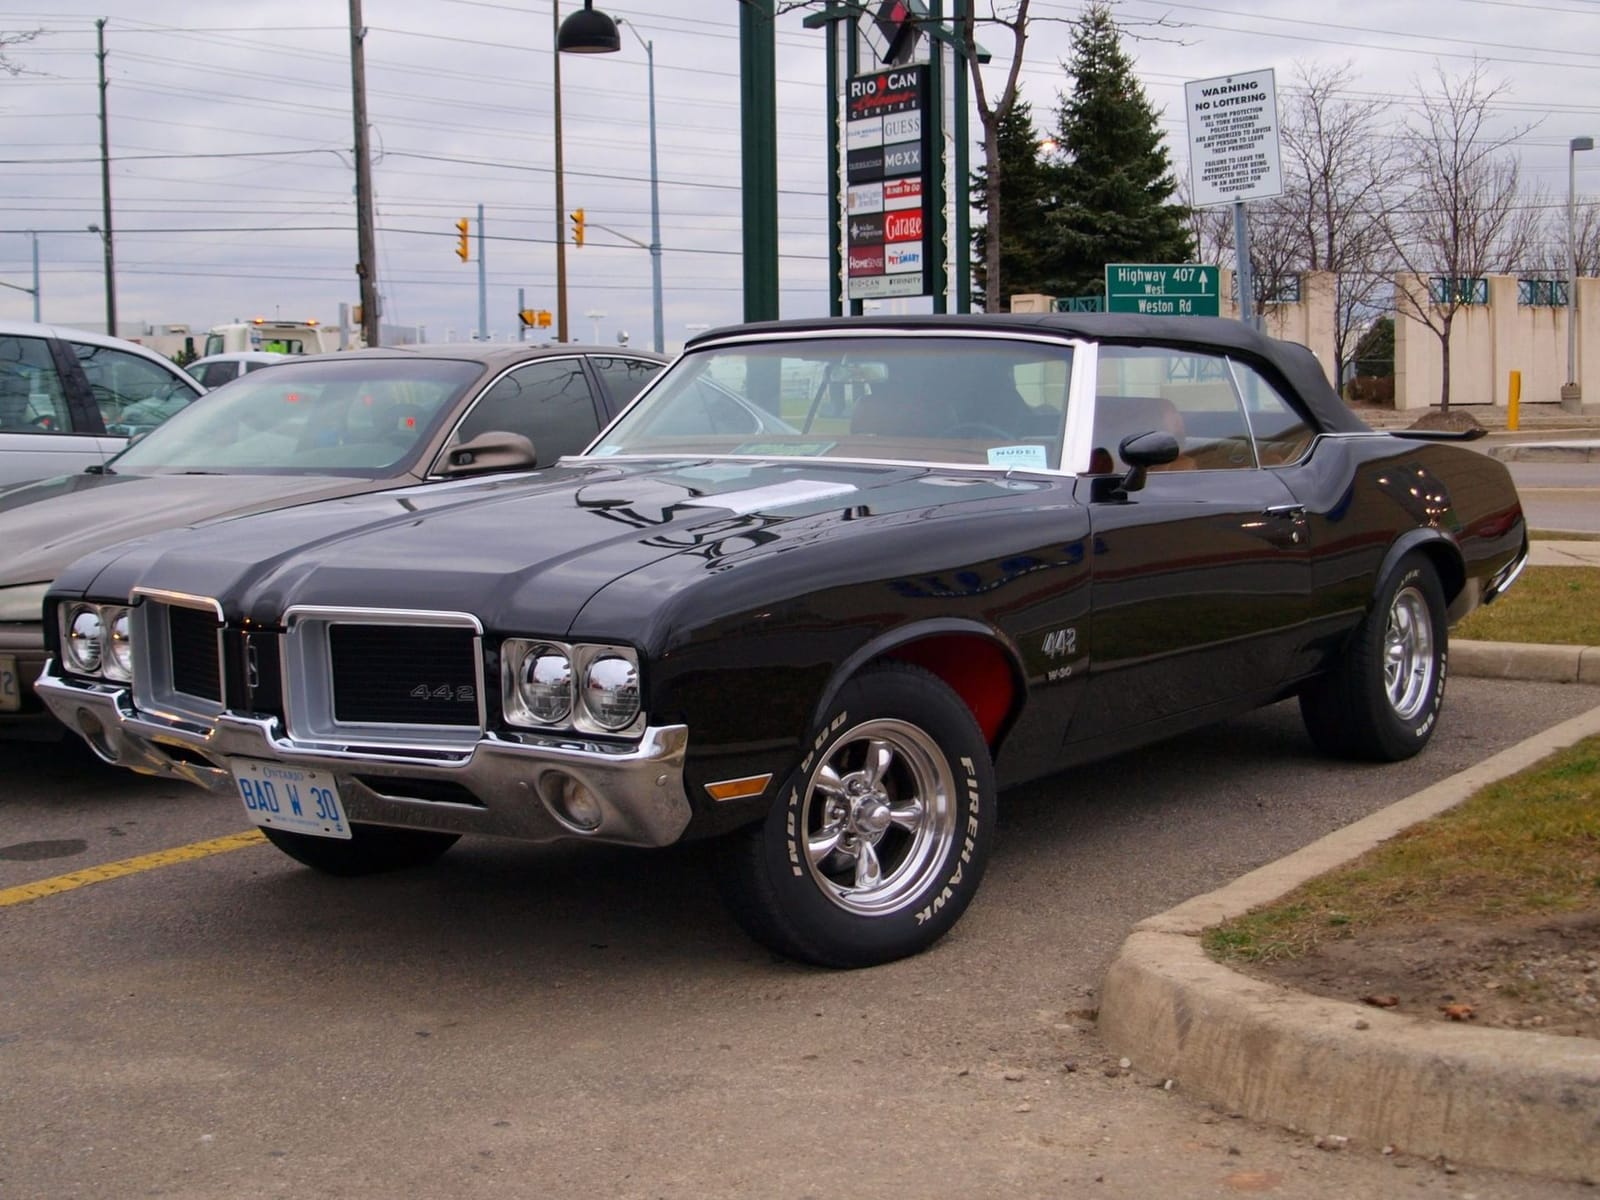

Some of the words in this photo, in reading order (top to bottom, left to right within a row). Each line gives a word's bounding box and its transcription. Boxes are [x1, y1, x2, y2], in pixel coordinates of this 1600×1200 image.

[851, 81, 876, 97] RIO
[888, 72, 917, 89] CAN
[1202, 81, 1258, 97] WARNING
[1195, 102, 1210, 111] NO
[1213, 93, 1266, 108] LOITERING
[1213, 112, 1227, 120] YOUR
[1229, 107, 1263, 117] PROTECTION
[885, 118, 920, 136] GUESS
[1210, 126, 1228, 134] POLICE
[1230, 122, 1254, 131] OFFICERS
[1207, 131, 1241, 141] AUTHORIZED
[1216, 138, 1237, 147] PERSON
[1248, 134, 1264, 142] LEAVE
[1228, 142, 1255, 152] PREMISES
[1204, 165, 1231, 174] PREMISES
[1205, 159, 1227, 167] FAILURE
[1202, 172, 1234, 181] INSTRUCTED
[1251, 166, 1270, 174] RESULT
[1219, 183, 1255, 193] TRESPASSING
[886, 215, 922, 240] Garage
[1118, 268, 1166, 286] Highway
[1173, 268, 1195, 282] 407
[1144, 284, 1165, 294] West
[1138, 300, 1174, 313] Weston
[1180, 300, 1192, 313] Rd
[1041, 628, 1076, 659] 442
[410, 684, 475, 702] 442
[801, 710, 847, 773] 500
[263, 767, 304, 781] ONTARIO
[239, 779, 279, 812] BAD
[286, 784, 303, 816] W
[310, 787, 339, 821] 30
[915, 757, 980, 926] FIREHAWK
